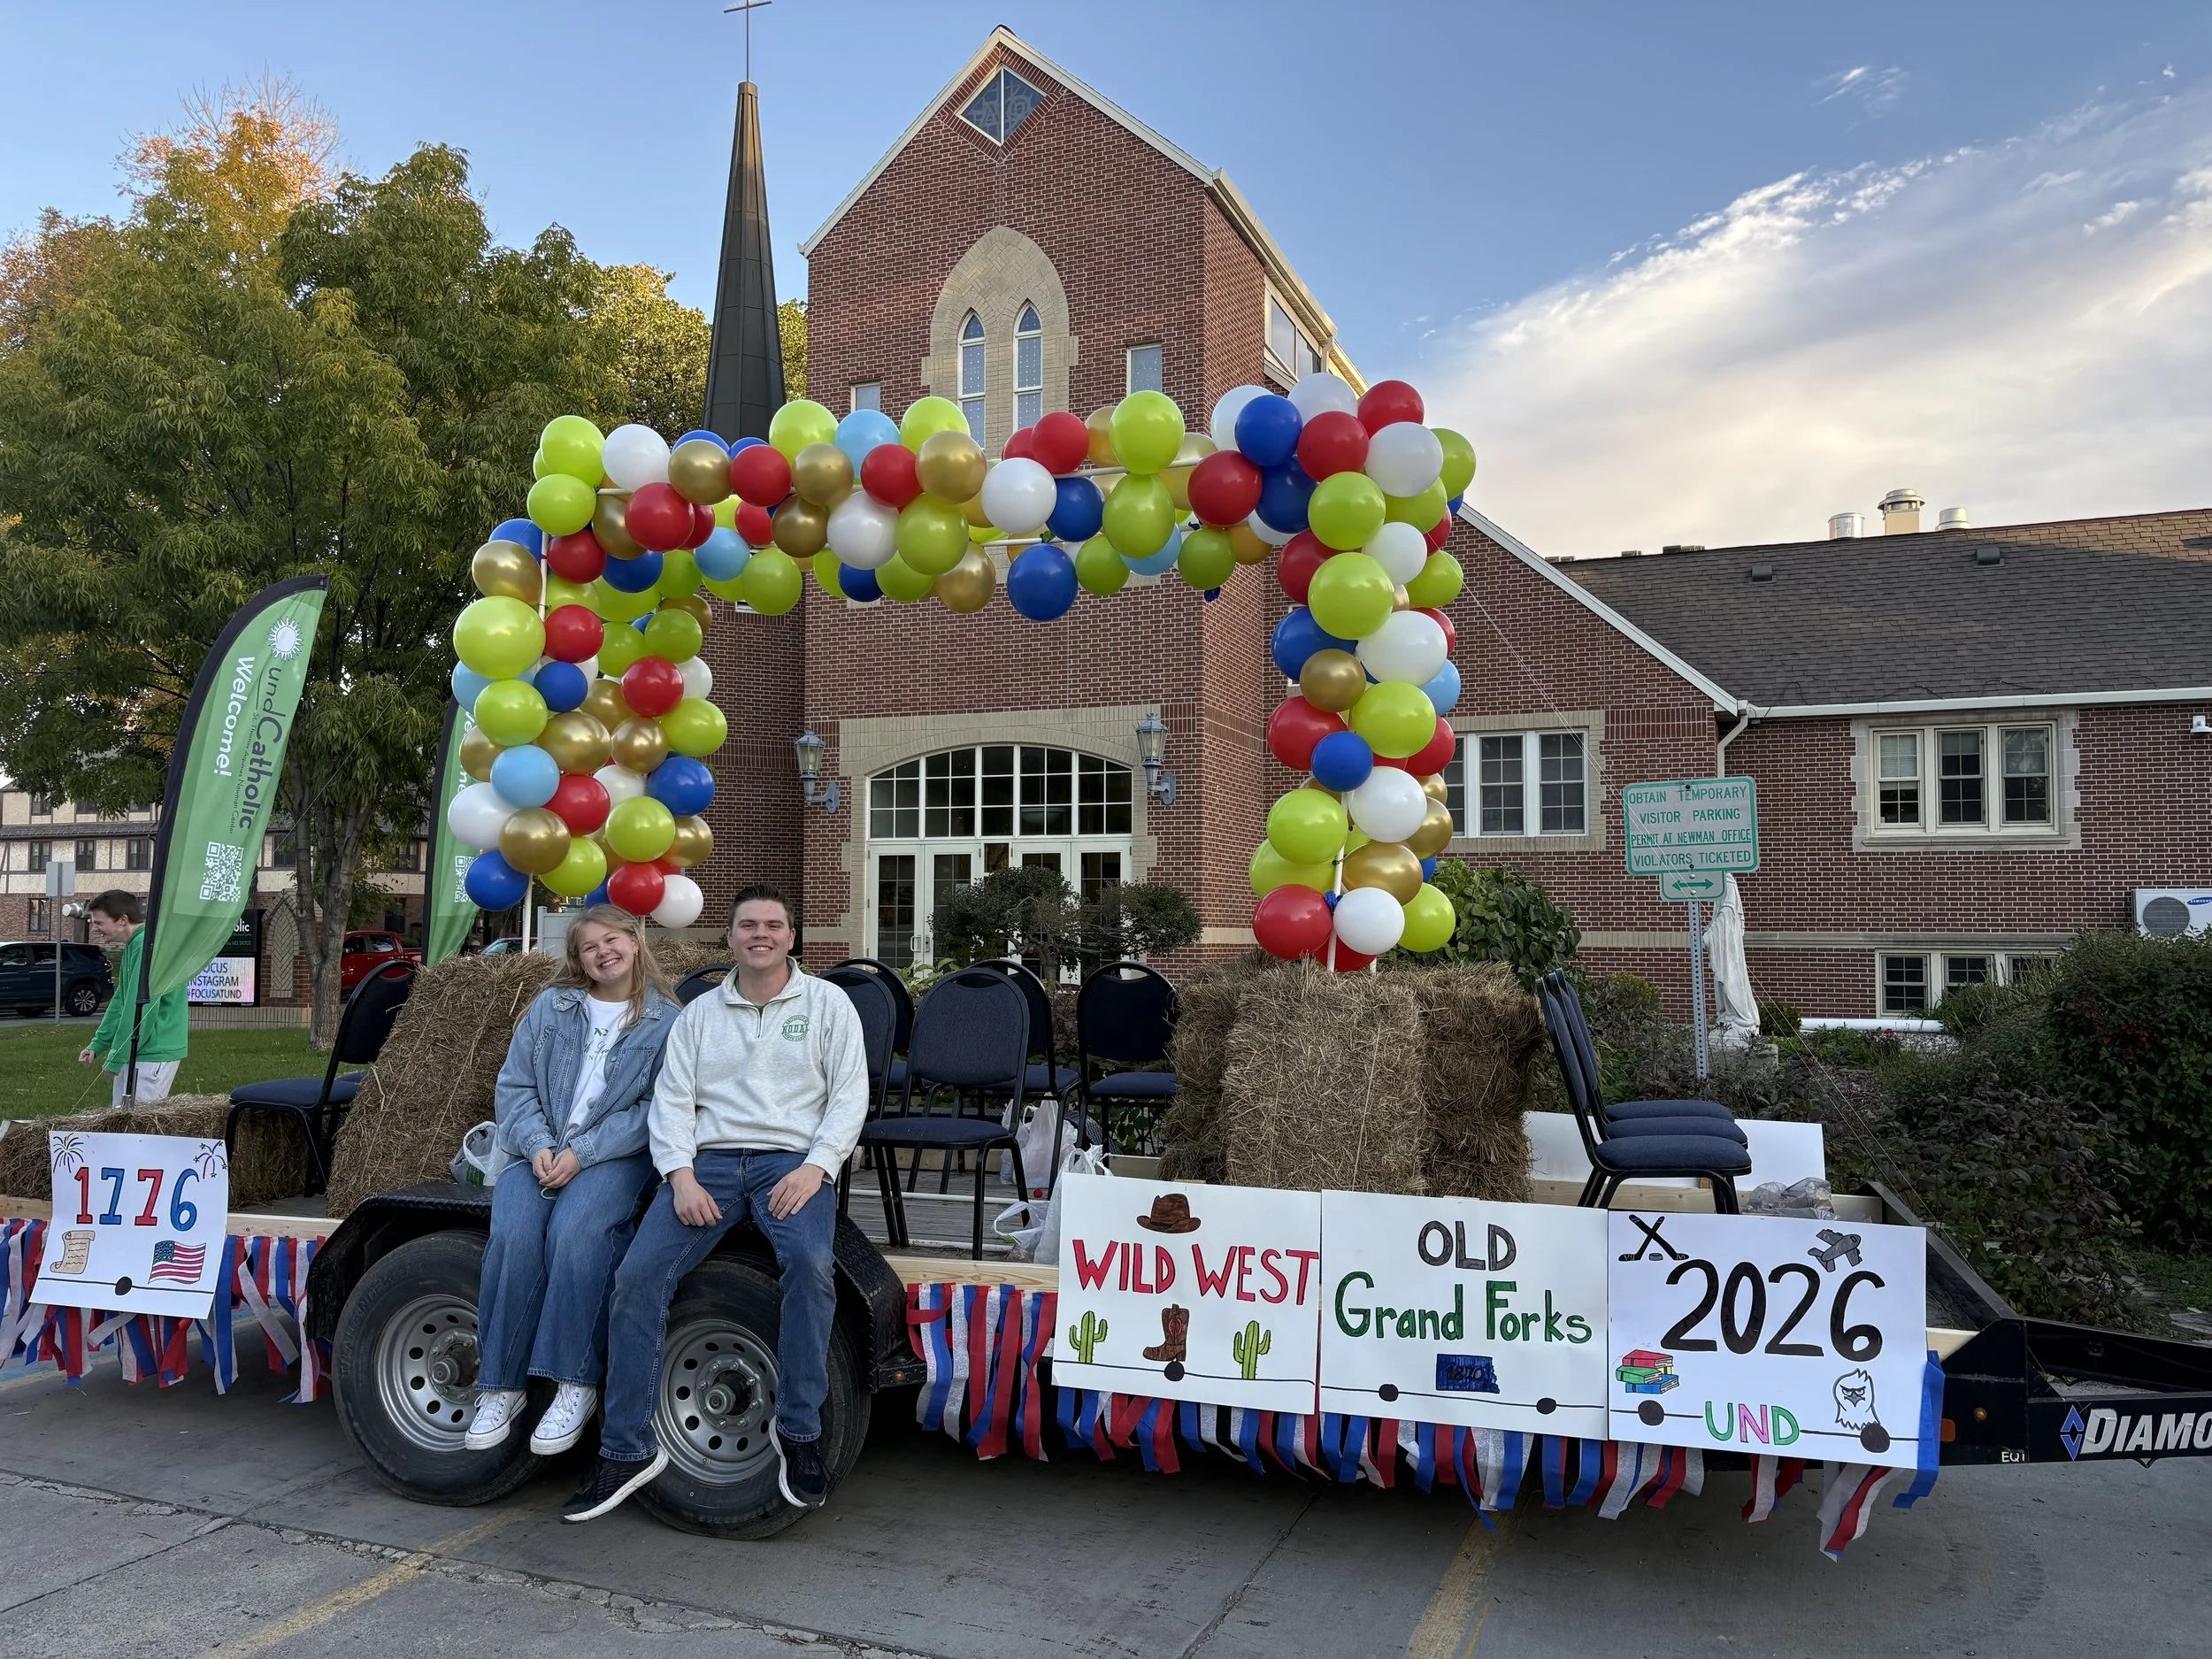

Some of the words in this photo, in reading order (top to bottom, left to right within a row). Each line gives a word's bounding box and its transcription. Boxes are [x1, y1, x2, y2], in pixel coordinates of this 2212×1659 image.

[213, 657, 255, 777] Welcome!
[234, 779, 245, 809] Newman
[1629, 790, 1667, 804] OBTAIN
[1678, 786, 1747, 802] TEMPORARY
[228, 810, 239, 834] Center
[1640, 810, 1680, 825] VISITOR
[1693, 808, 1740, 822] PARKING
[1631, 833, 1659, 846] PERMIT
[1663, 833, 1672, 844] AT
[1678, 831, 1715, 843] NEWMAN
[1722, 828, 1752, 841] OFFICE
[1634, 853, 1693, 867] VIOLATORS
[1699, 850, 1751, 864] TICKETED
[203, 963, 228, 973] OCUS
[73, 1166, 200, 1232] 1776
[1417, 1220, 1517, 1272] OLD
[1072, 1239, 1176, 1294] WILD
[1191, 1243, 1319, 1306] WEST
[1334, 1271, 1463, 1341] Grand
[1486, 1280, 1593, 1344] Forks
[1660, 1258, 1886, 1362] 2026
[1703, 1401, 1801, 1446] UND
